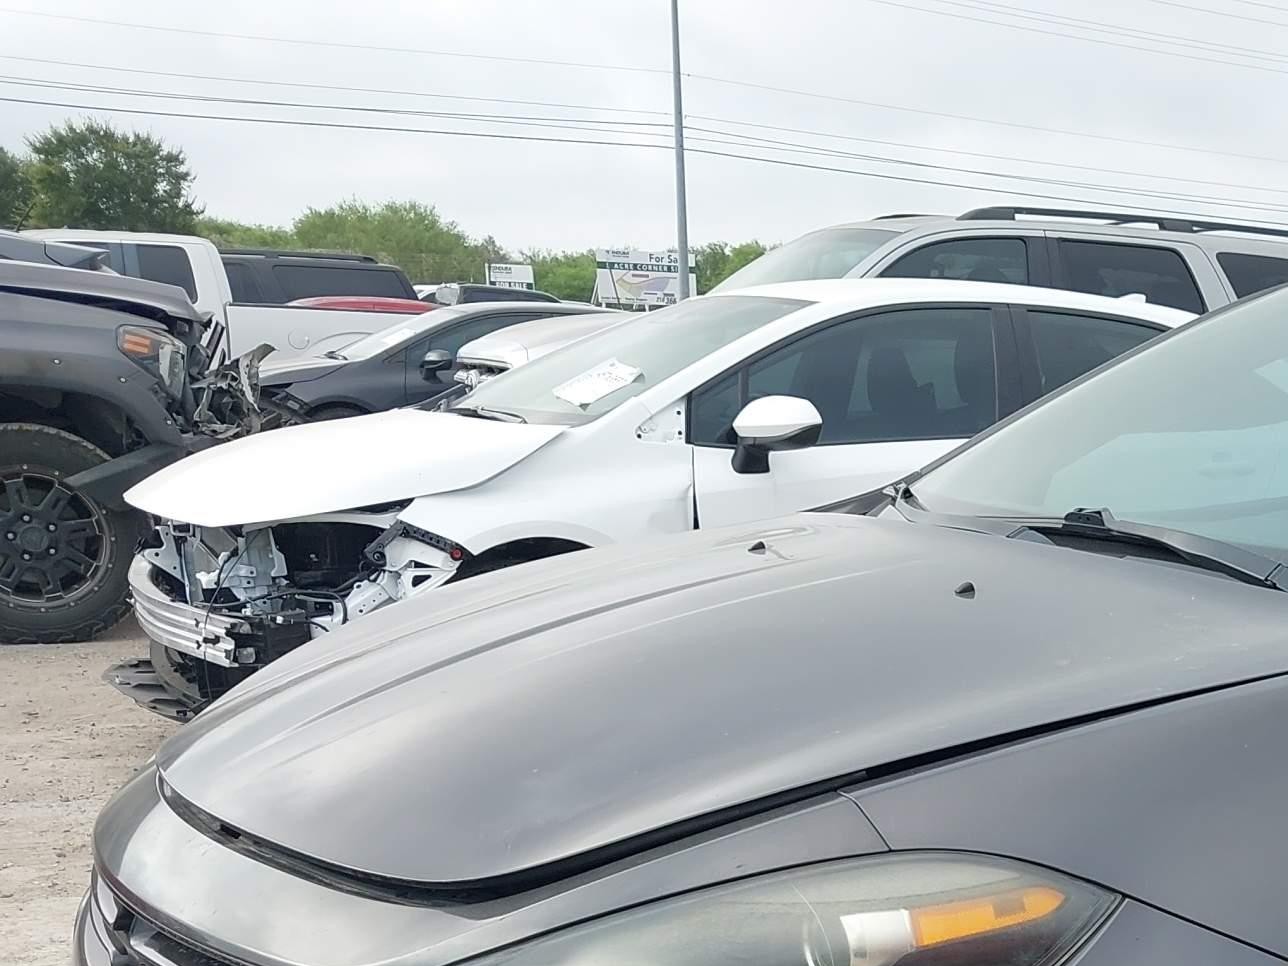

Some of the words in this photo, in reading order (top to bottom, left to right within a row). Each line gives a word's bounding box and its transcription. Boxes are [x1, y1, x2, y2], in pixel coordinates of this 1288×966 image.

[648, 253, 665, 264] For
[613, 263, 634, 271] ACRE
[636, 264, 668, 273] CORNER
